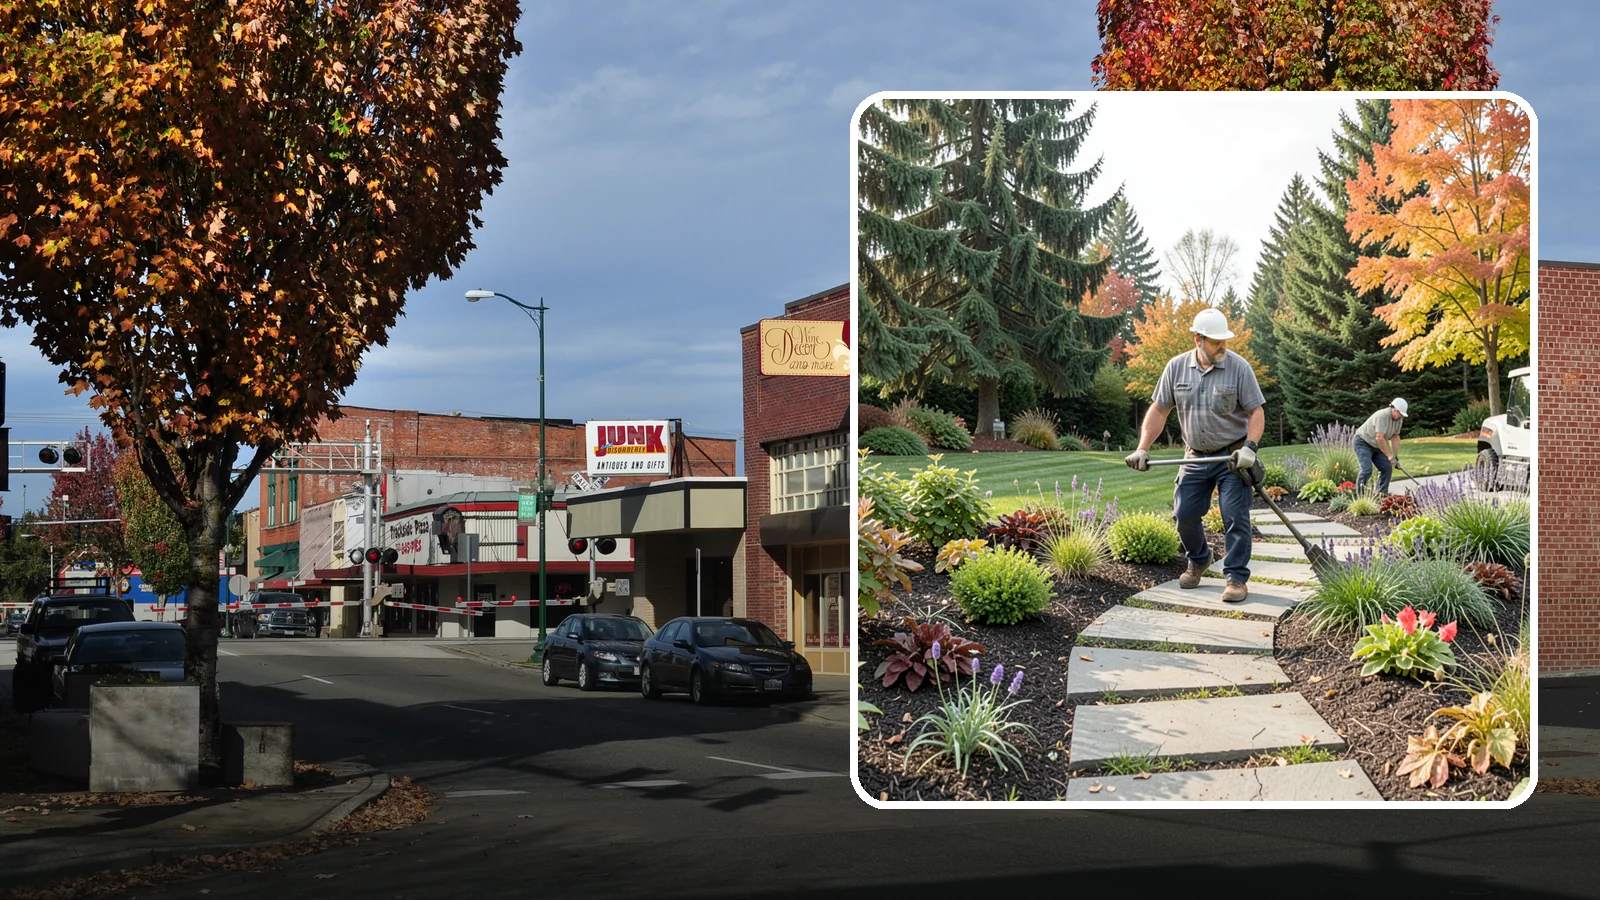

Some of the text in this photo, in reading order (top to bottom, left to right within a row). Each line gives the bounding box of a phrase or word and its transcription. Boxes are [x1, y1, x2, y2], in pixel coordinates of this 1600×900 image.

[791, 324, 824, 344] Wine
[765, 327, 831, 365] Decor
[596, 425, 666, 457] JUNK
[607, 446, 646, 454] DISORDERLY
[596, 460, 665, 470] ANTIQUES AND GIFTS
[414, 519, 429, 535] Pizza
